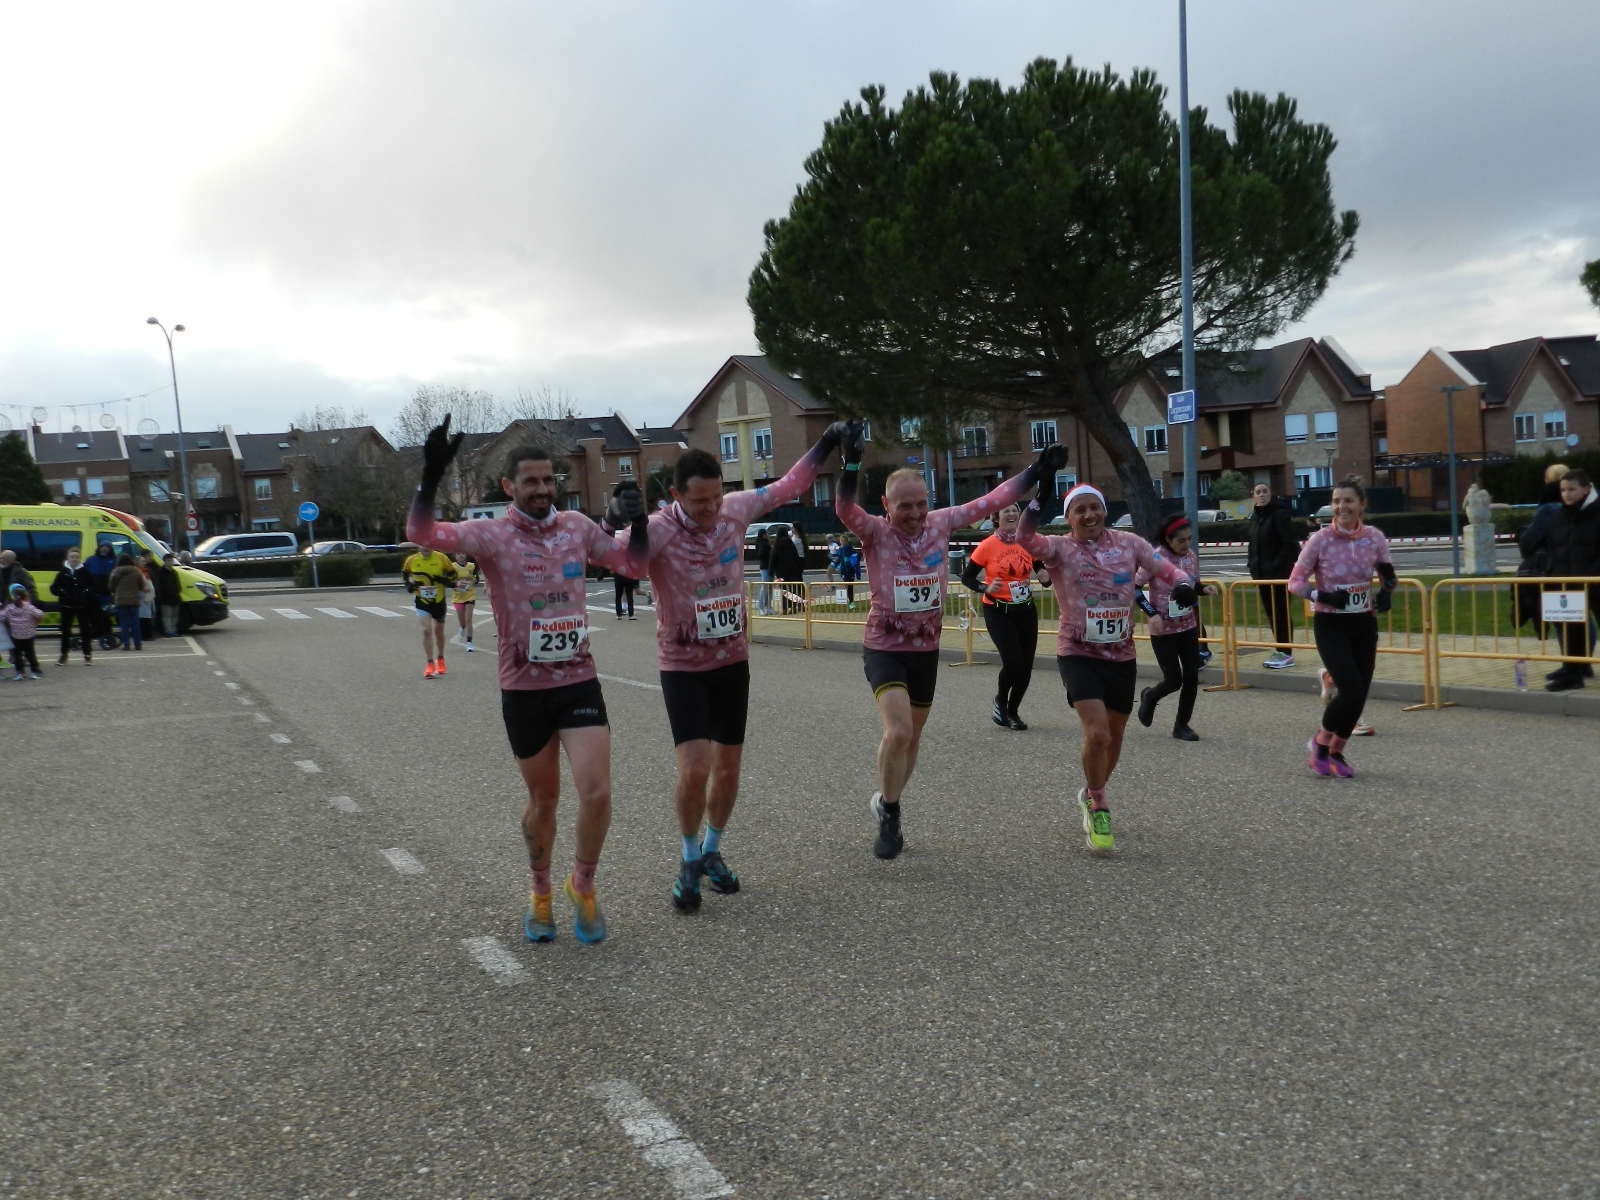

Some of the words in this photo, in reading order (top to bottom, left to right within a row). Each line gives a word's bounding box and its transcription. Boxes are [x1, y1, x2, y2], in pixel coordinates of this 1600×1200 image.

[10, 517, 80, 526] AMBULANCIA
[709, 576, 728, 590] SIS
[547, 592, 570, 603] SIS
[909, 587, 931, 603] 39
[707, 608, 737, 628] 108
[1096, 619, 1123, 635] 151
[540, 630, 579, 652] 239
